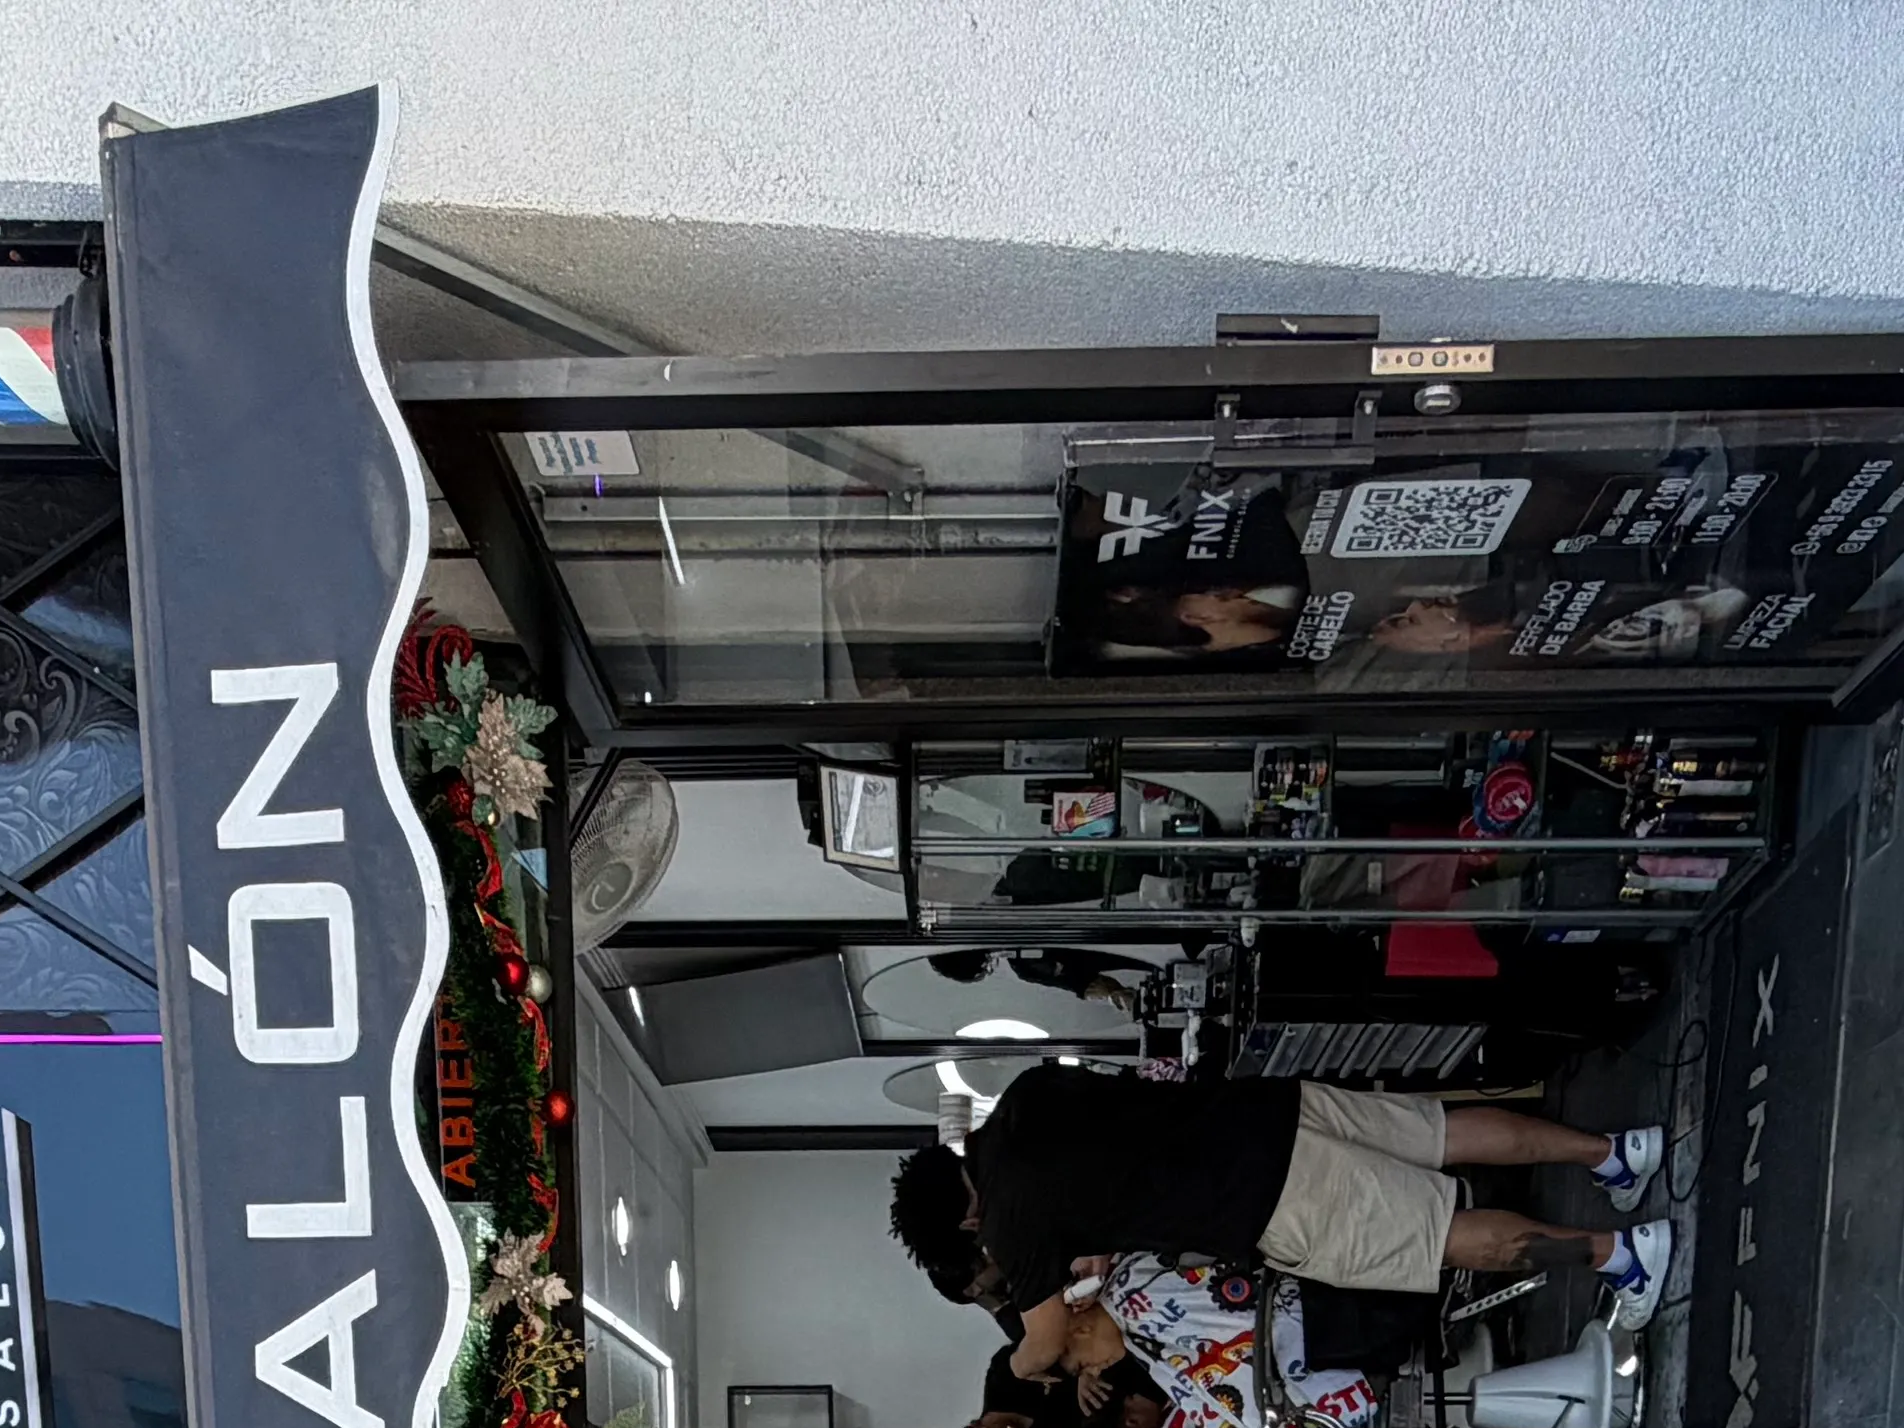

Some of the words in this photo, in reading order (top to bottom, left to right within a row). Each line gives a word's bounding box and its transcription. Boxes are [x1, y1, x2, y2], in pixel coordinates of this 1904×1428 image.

[1186, 489, 1234, 560] FNIX
[1302, 594, 1328, 614] DE
[1308, 591, 1355, 661] CABELLO
[1508, 580, 1573, 656] PERFILADO
[1553, 579, 1606, 632] BARBA
[1722, 593, 1787, 650] LIMPIEZA
[1748, 592, 1817, 649] FACIAL
[1286, 615, 1320, 658] CORTE
[1538, 634, 1569, 655] DE
[434, 993, 477, 1188] ABIER
[1736, 953, 1780, 1266] FNIX
